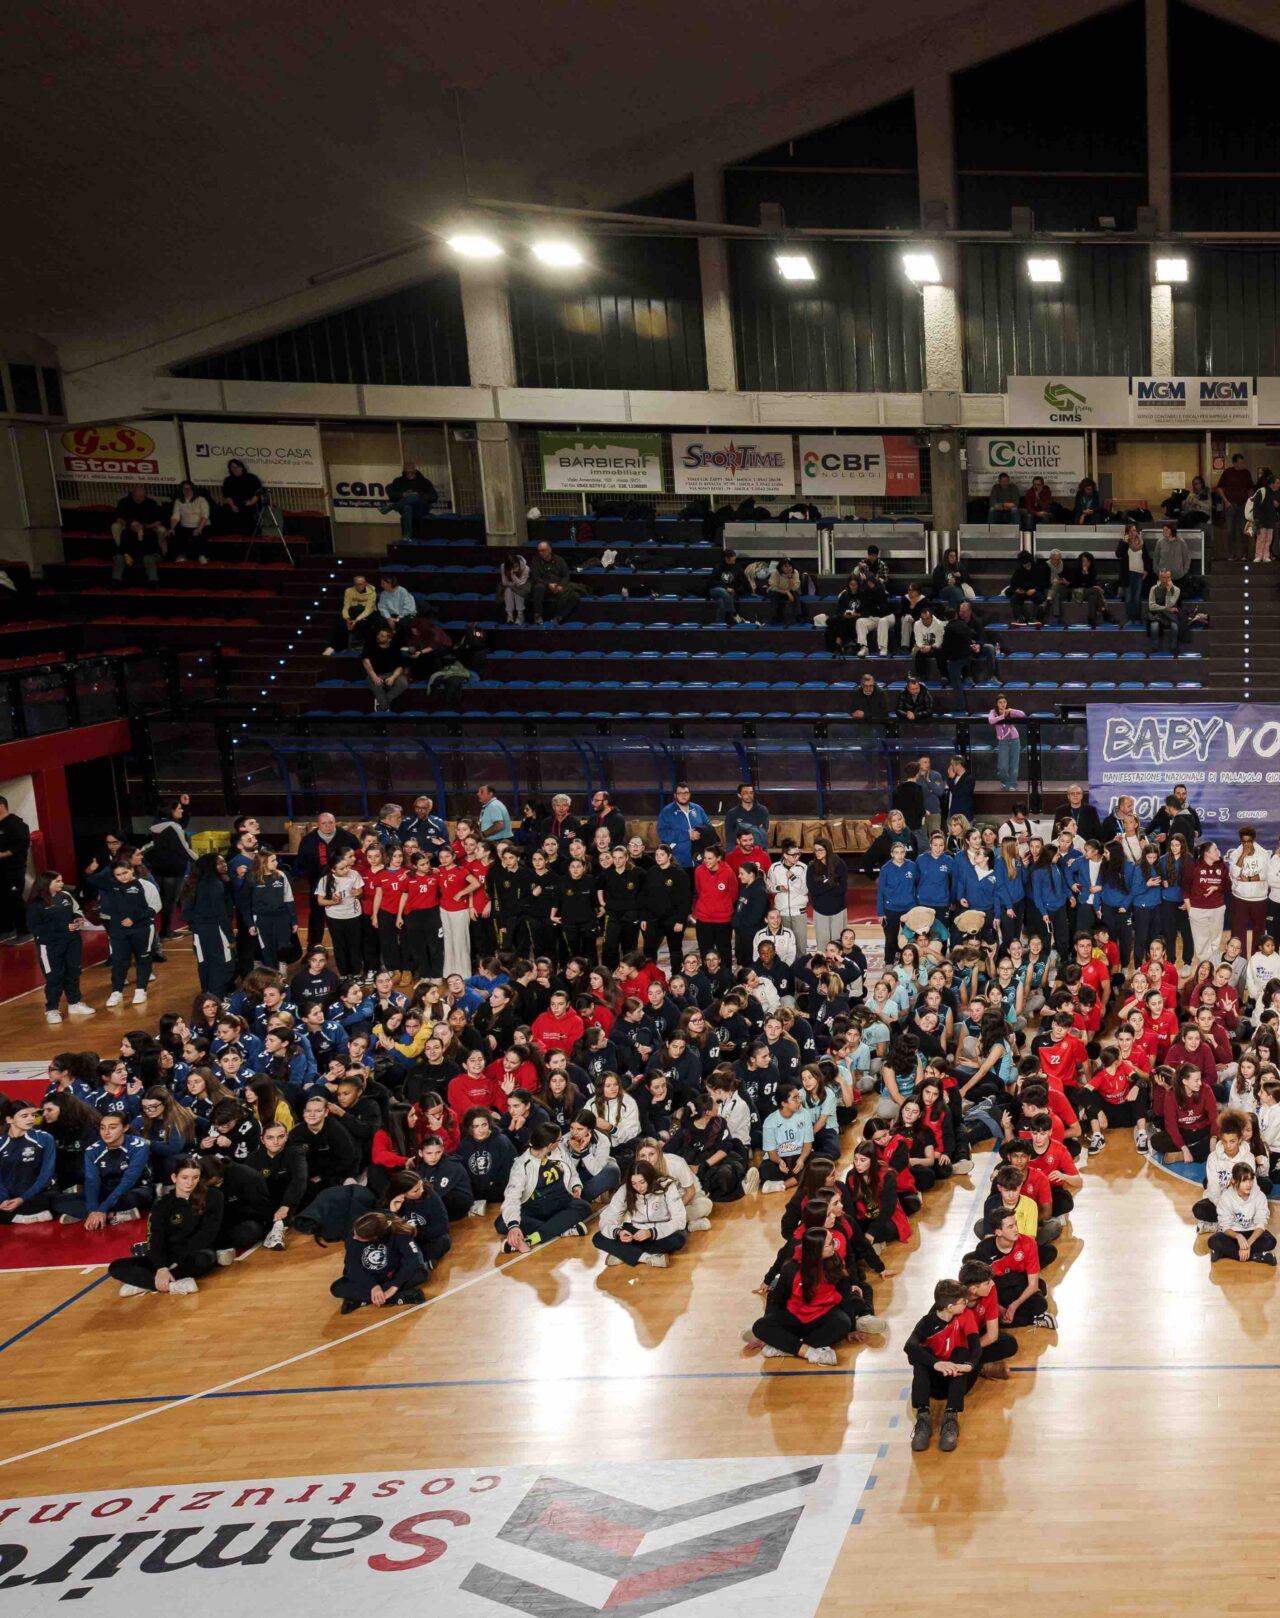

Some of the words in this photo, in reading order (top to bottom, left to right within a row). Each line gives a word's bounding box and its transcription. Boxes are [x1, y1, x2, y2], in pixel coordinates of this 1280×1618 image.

[1138, 382, 1185, 399] MGM
[1200, 382, 1248, 399] MGM
[1049, 414, 1082, 422] CIMS
[210, 446, 271, 458] CIACCIO
[275, 447, 311, 458] CASA
[1017, 441, 1061, 455] clinic
[70, 459, 154, 473] store
[559, 457, 641, 468] BARBIERI
[821, 453, 880, 471] CBF
[1018, 457, 1061, 467] center
[1102, 715, 1223, 765] BABY
[1102, 771, 1161, 783] MANIFESTAZIONE
[1164, 771, 1205, 782] NAZIONALE
[1208, 772, 1216, 782] DI
[1219, 771, 1263, 783] PALLAVOLO
[1218, 807, 1230, 822] 3
[419, 884, 428, 893] 26
[709, 1046, 720, 1058] 67
[1050, 1055, 1061, 1065] 22
[108, 1101, 125, 1112] 38
[784, 1129, 795, 1141] 16
[542, 1167, 560, 1186] 21
